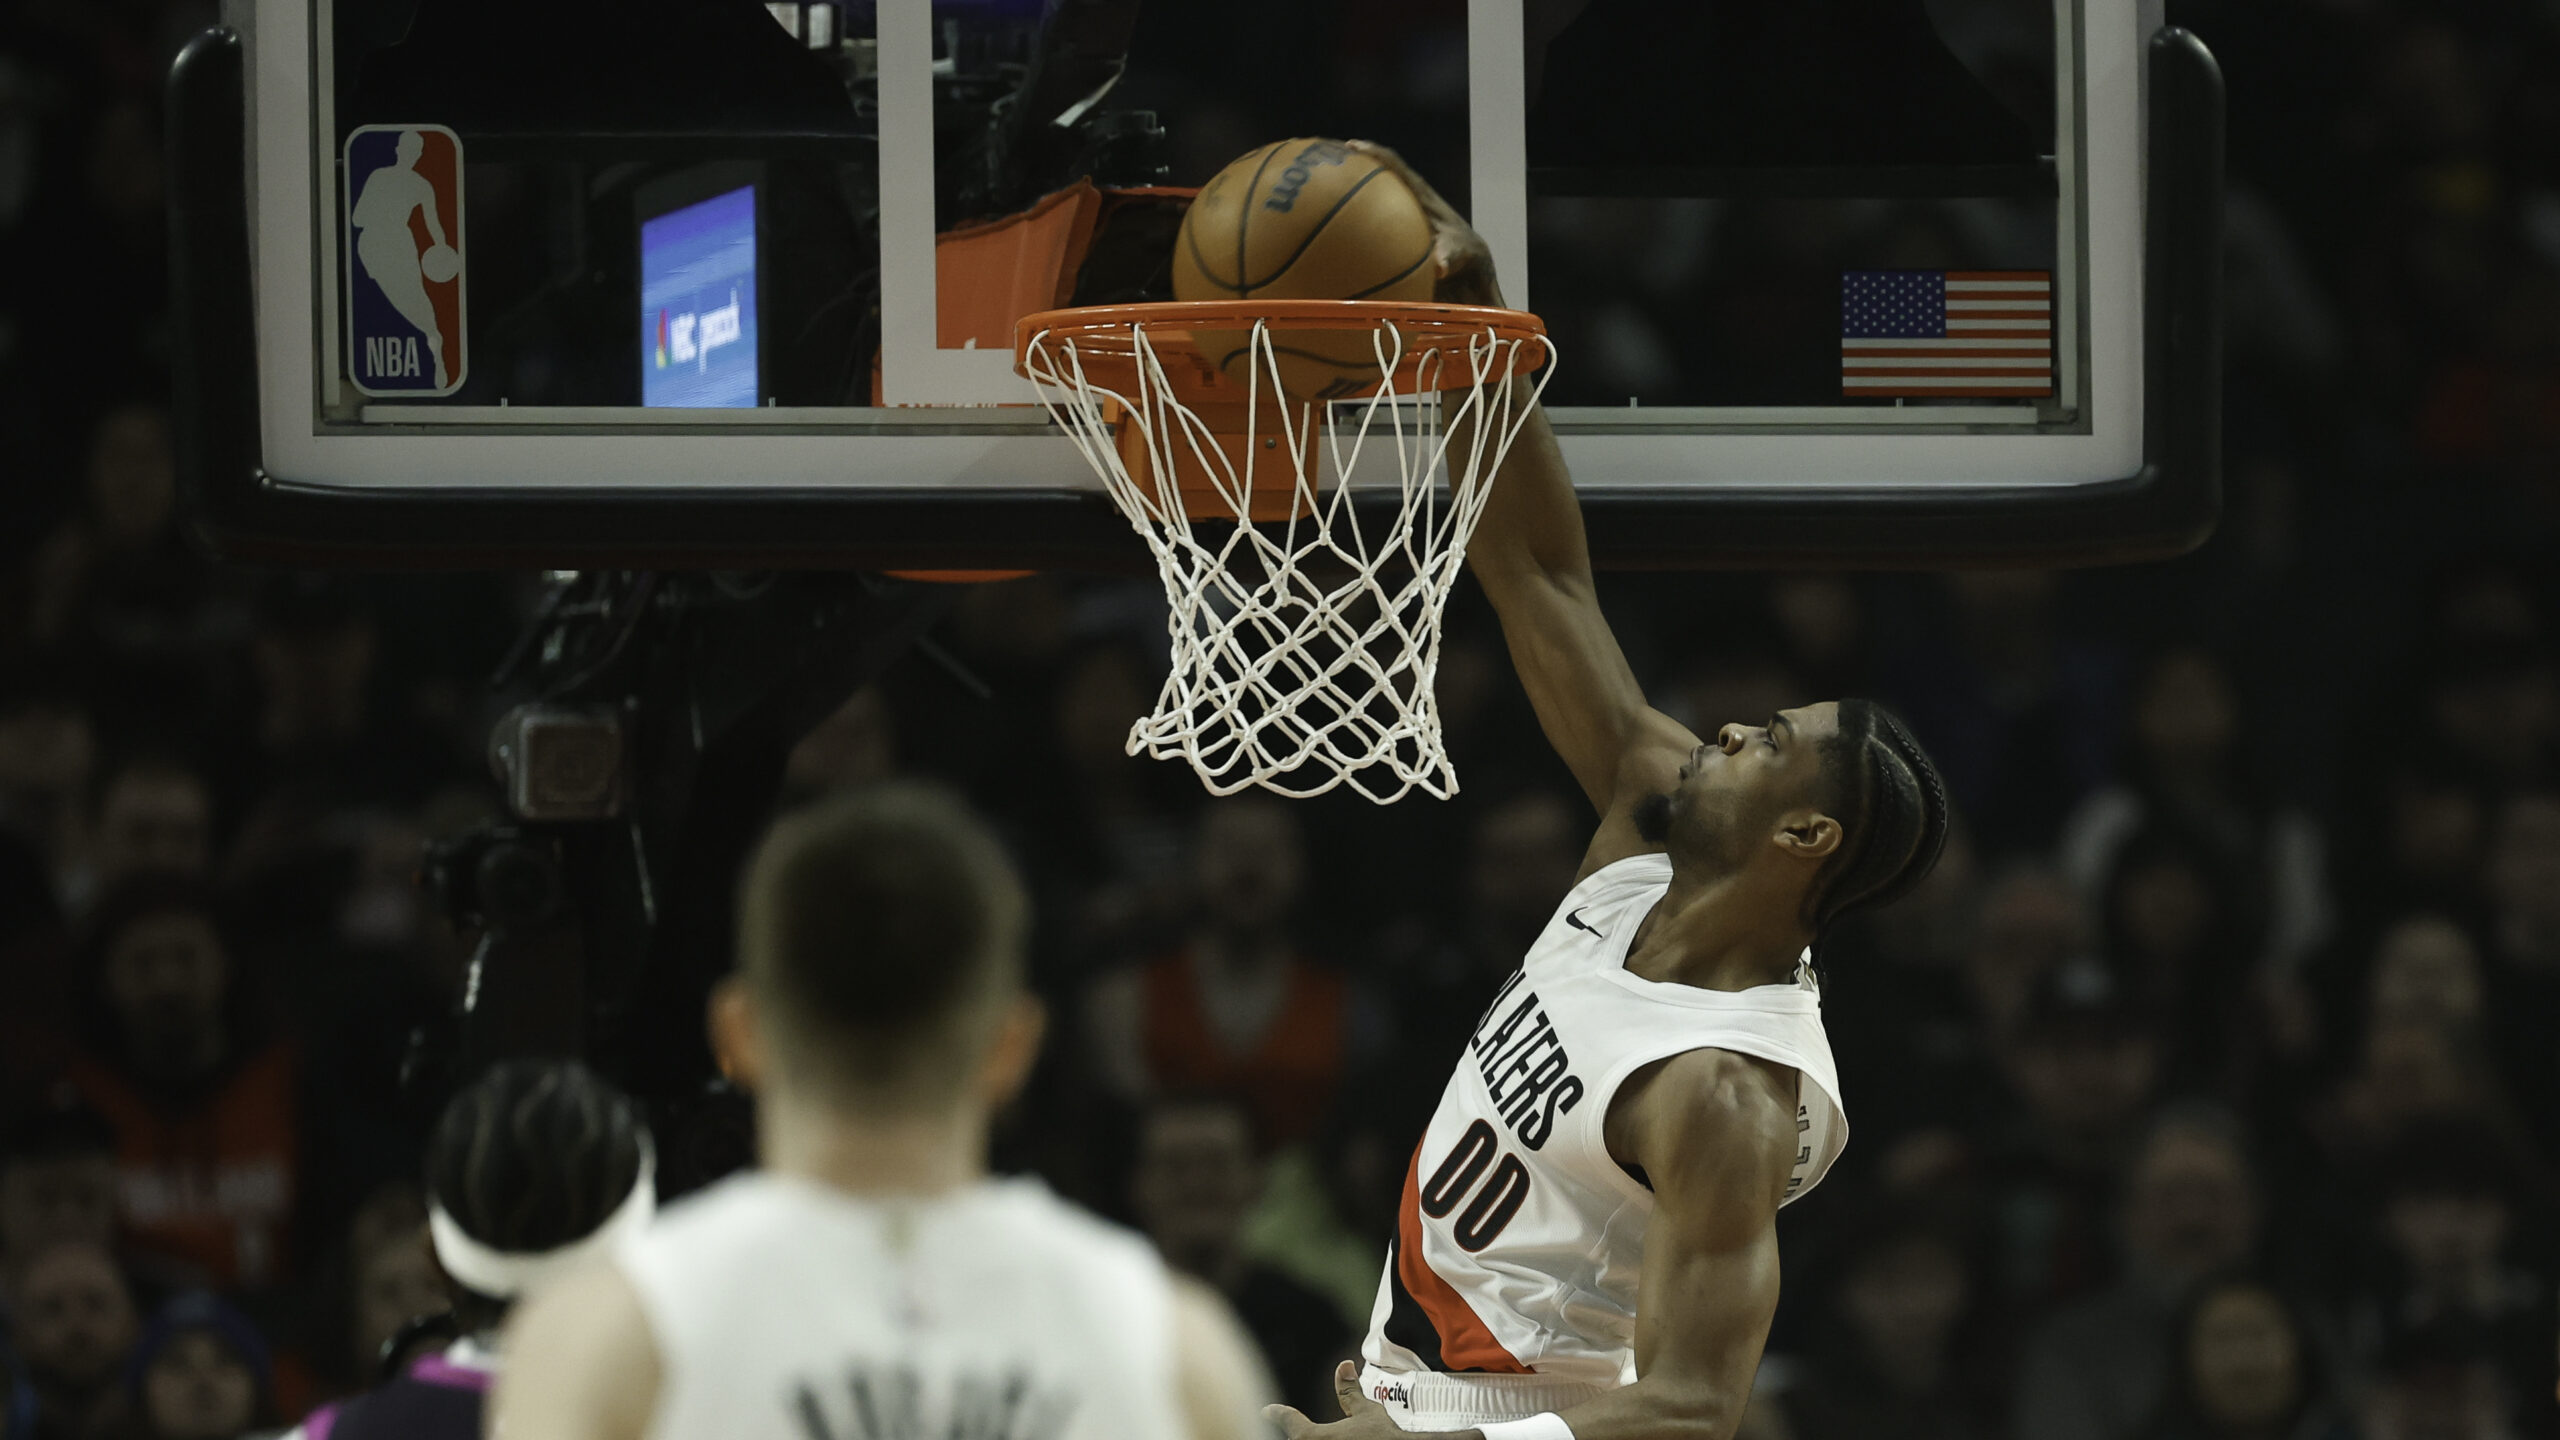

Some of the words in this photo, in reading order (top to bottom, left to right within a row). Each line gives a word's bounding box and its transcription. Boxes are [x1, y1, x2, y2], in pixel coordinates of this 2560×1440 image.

[366, 336, 421, 377] NBA
[1471, 969, 1584, 1152] LAZERS
[1420, 1118, 1531, 1253] 00
[1373, 1380, 1409, 1409] ripcity
